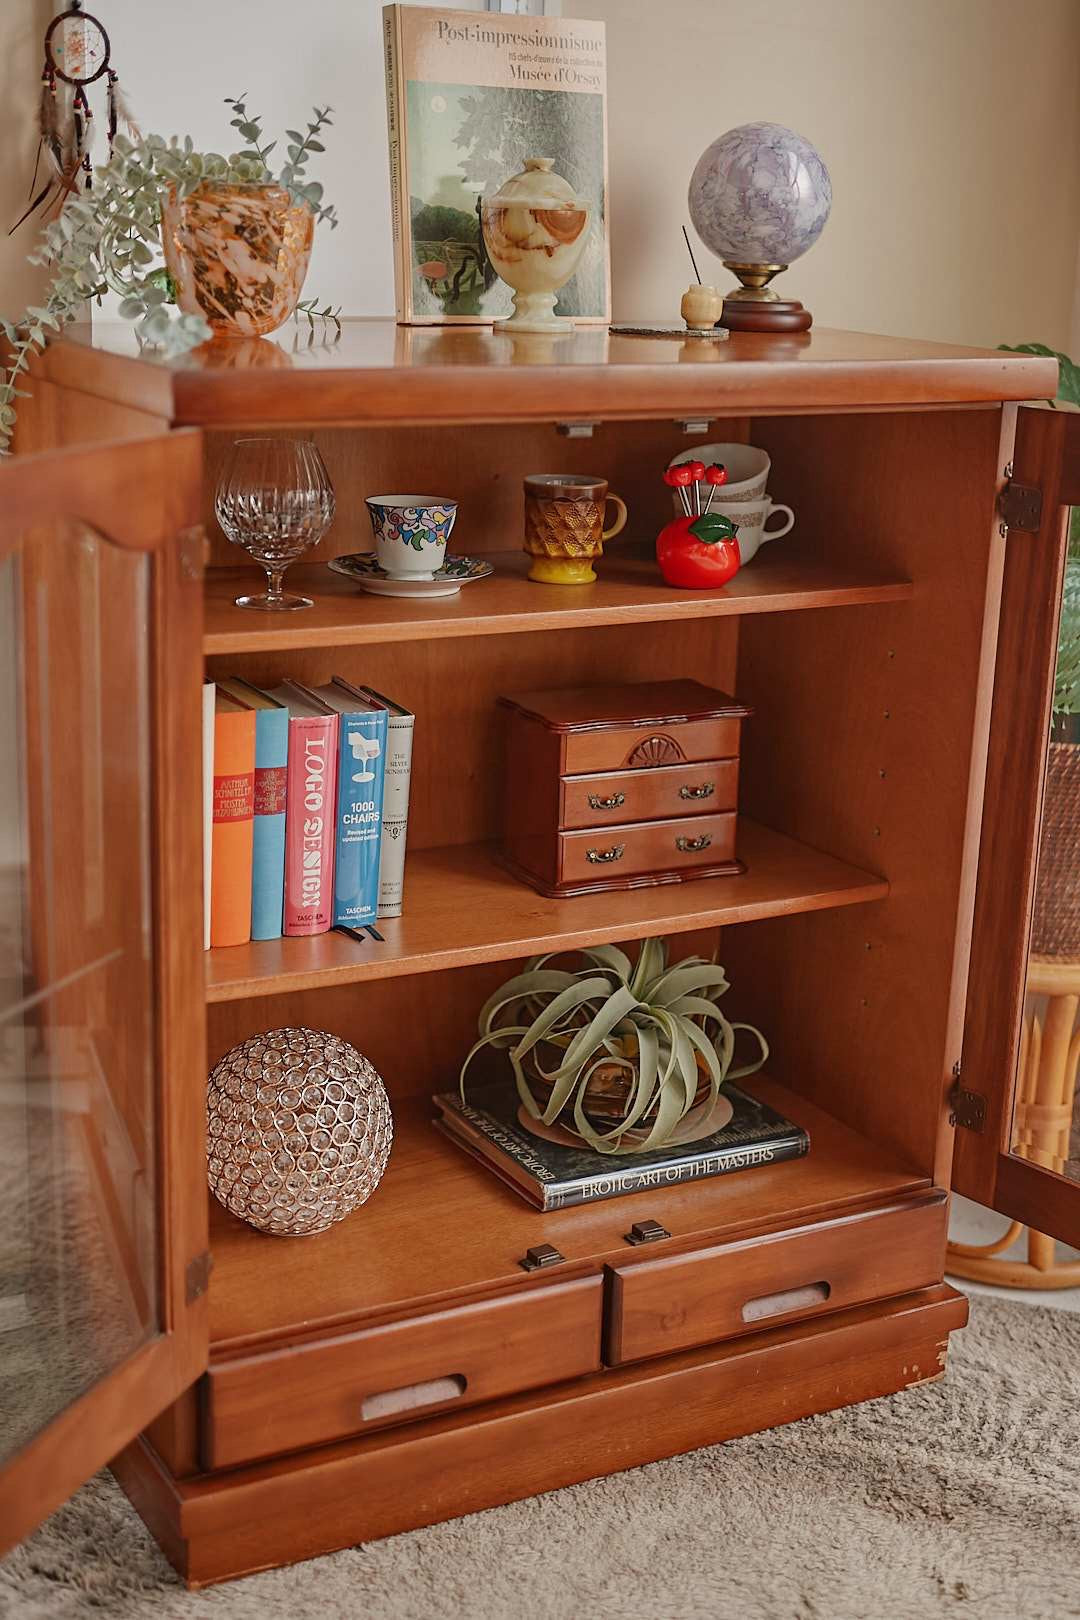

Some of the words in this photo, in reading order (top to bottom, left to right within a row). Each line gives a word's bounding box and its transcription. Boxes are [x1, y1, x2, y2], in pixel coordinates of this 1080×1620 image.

[437, 20, 602, 50] Post-impressionnisme
[510, 64, 552, 81] Musée
[554, 67, 601, 90] d'Orsay
[304, 736, 325, 812] LOGO
[343, 811, 380, 824] CHAIRS
[351, 801, 375, 813] 1000
[302, 816, 324, 908] DESIGN
[346, 905, 371, 914] TASCHEN
[517, 1154, 556, 1180] EROTIC
[582, 1176, 633, 1198] EROTIC
[636, 1171, 662, 1186] ART
[665, 1166, 686, 1181] OF
[688, 1160, 715, 1176] THE
[717, 1148, 775, 1171] MASTERS
